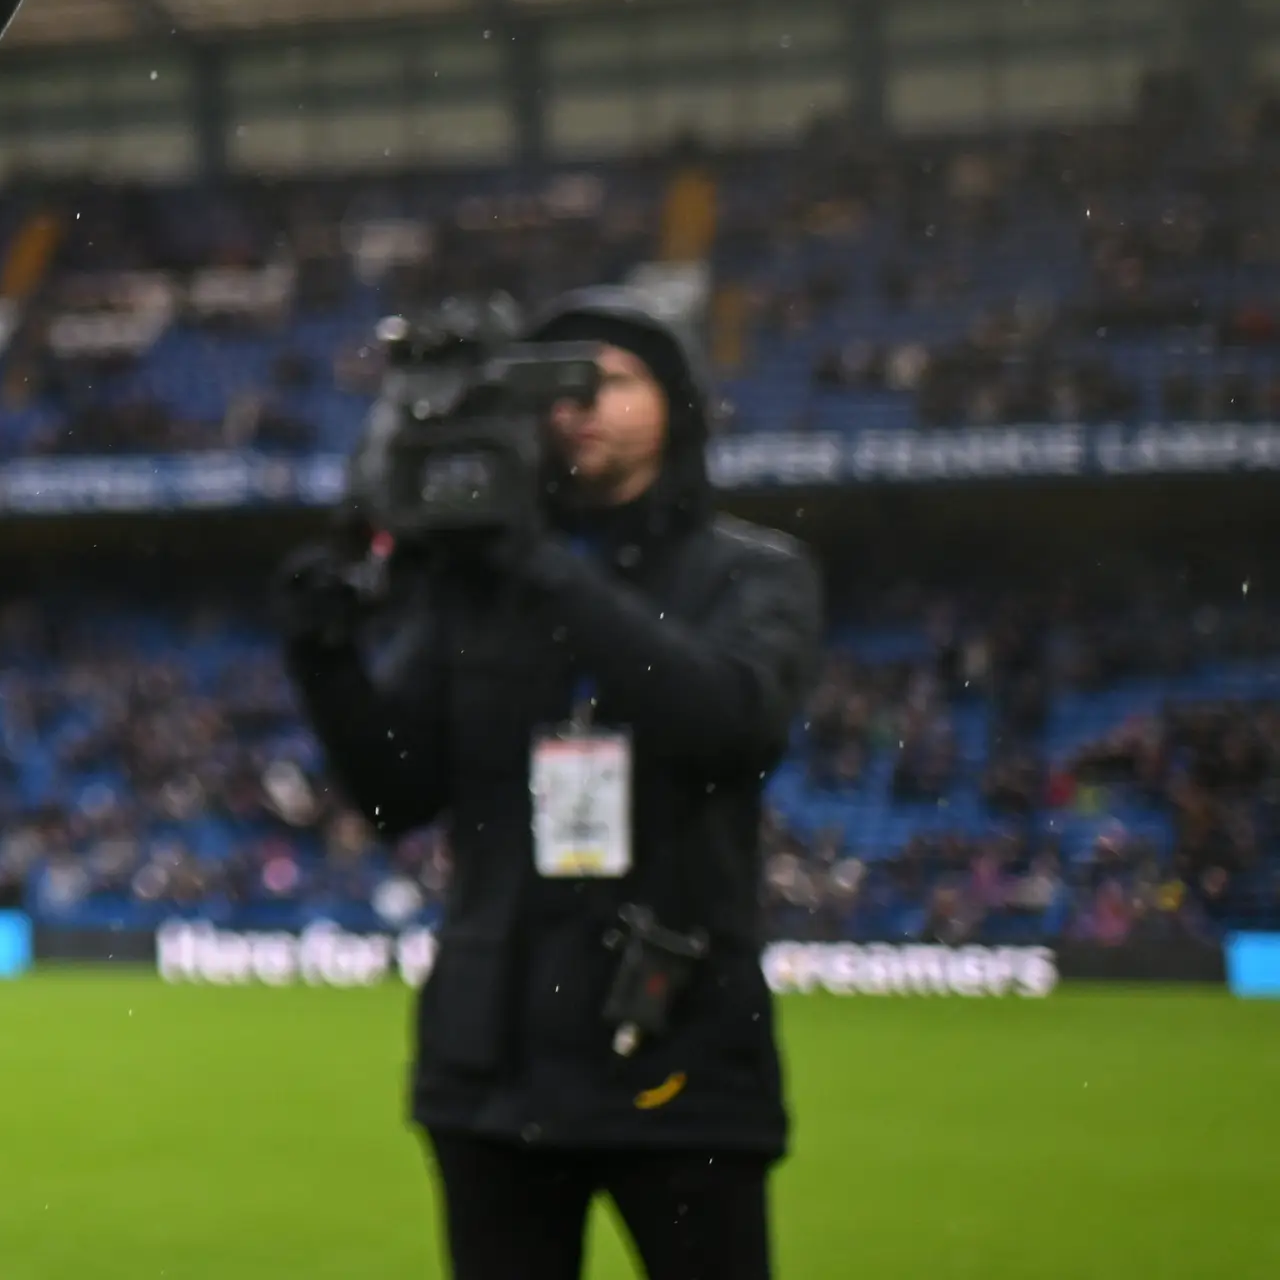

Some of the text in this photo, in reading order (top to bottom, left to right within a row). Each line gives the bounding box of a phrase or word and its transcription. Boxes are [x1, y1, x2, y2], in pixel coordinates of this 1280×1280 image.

[706, 431, 839, 486] UPER
[156, 920, 296, 986] Here
[298, 920, 392, 987] for
